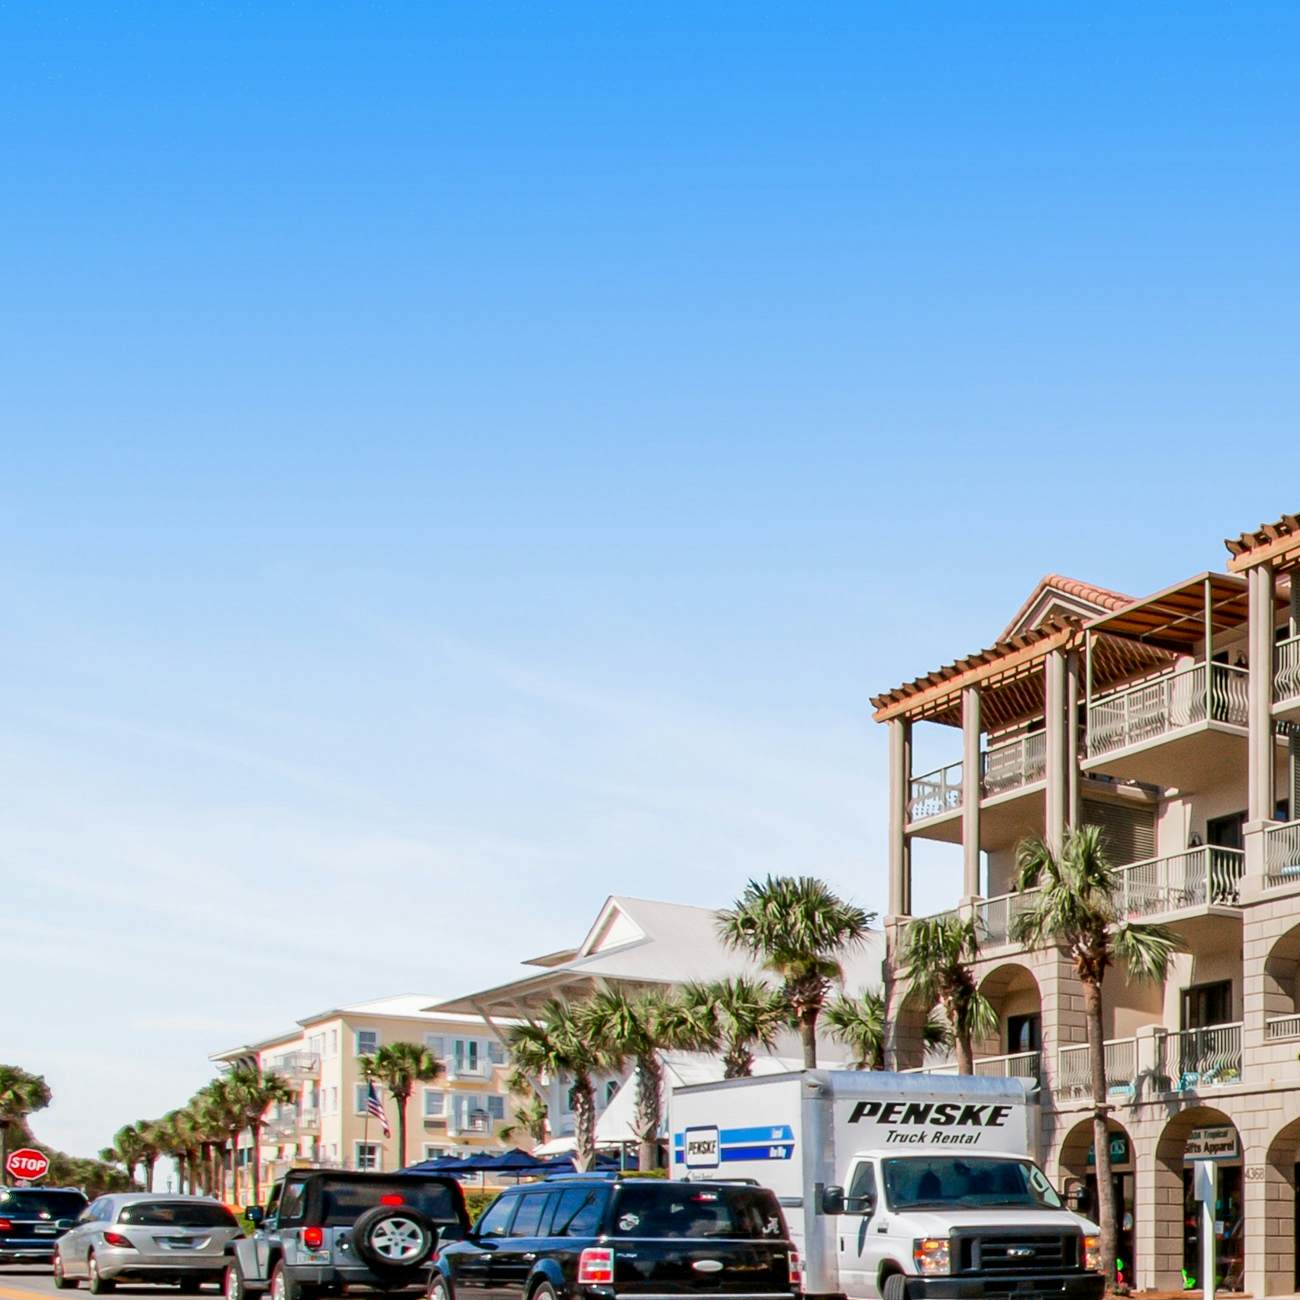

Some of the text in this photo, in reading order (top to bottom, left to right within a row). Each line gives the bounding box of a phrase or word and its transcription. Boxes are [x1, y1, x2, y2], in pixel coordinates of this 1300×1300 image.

[848, 1101, 1012, 1127] PENSKE
[886, 1130, 981, 1145] Truck Rental
[688, 1140, 717, 1156] PENSKE
[1203, 1140, 1234, 1155] Apparel
[10, 1156, 46, 1171] STOP
